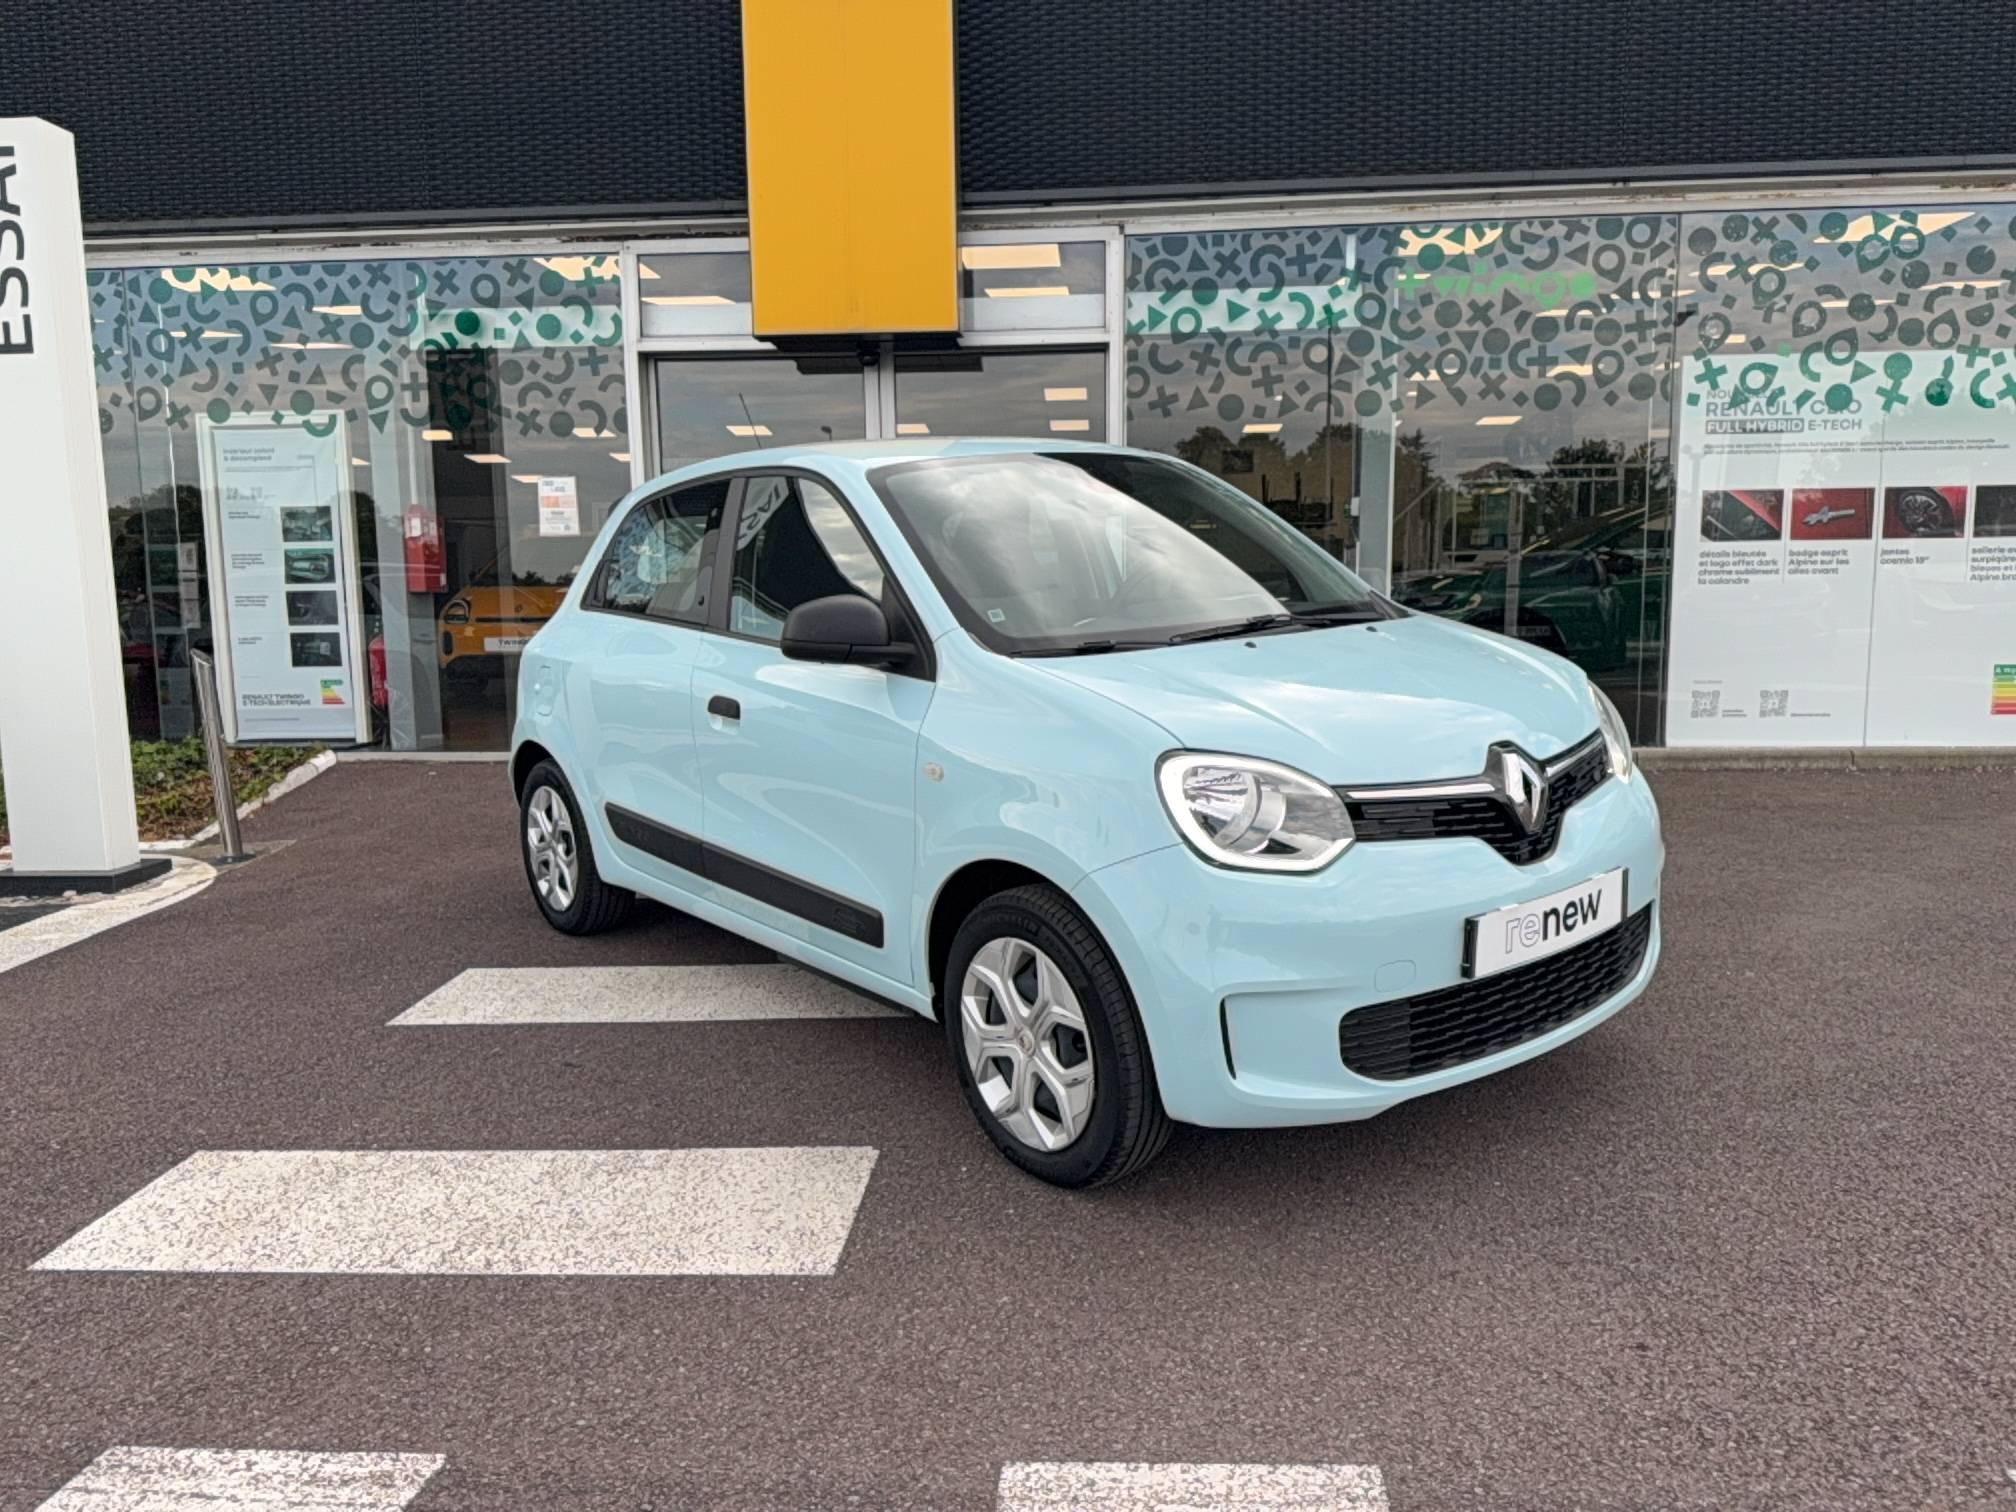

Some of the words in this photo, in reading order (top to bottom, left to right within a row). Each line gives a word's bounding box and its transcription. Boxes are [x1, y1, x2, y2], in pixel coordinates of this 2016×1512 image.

[0, 146, 34, 354] ESS
[1707, 421, 1742, 433] FULL
[1746, 420, 1803, 432] HYBRID
[1808, 419, 1863, 431] E-TECH
[1810, 400, 1863, 415] CO
[1504, 888, 1603, 954] renew
